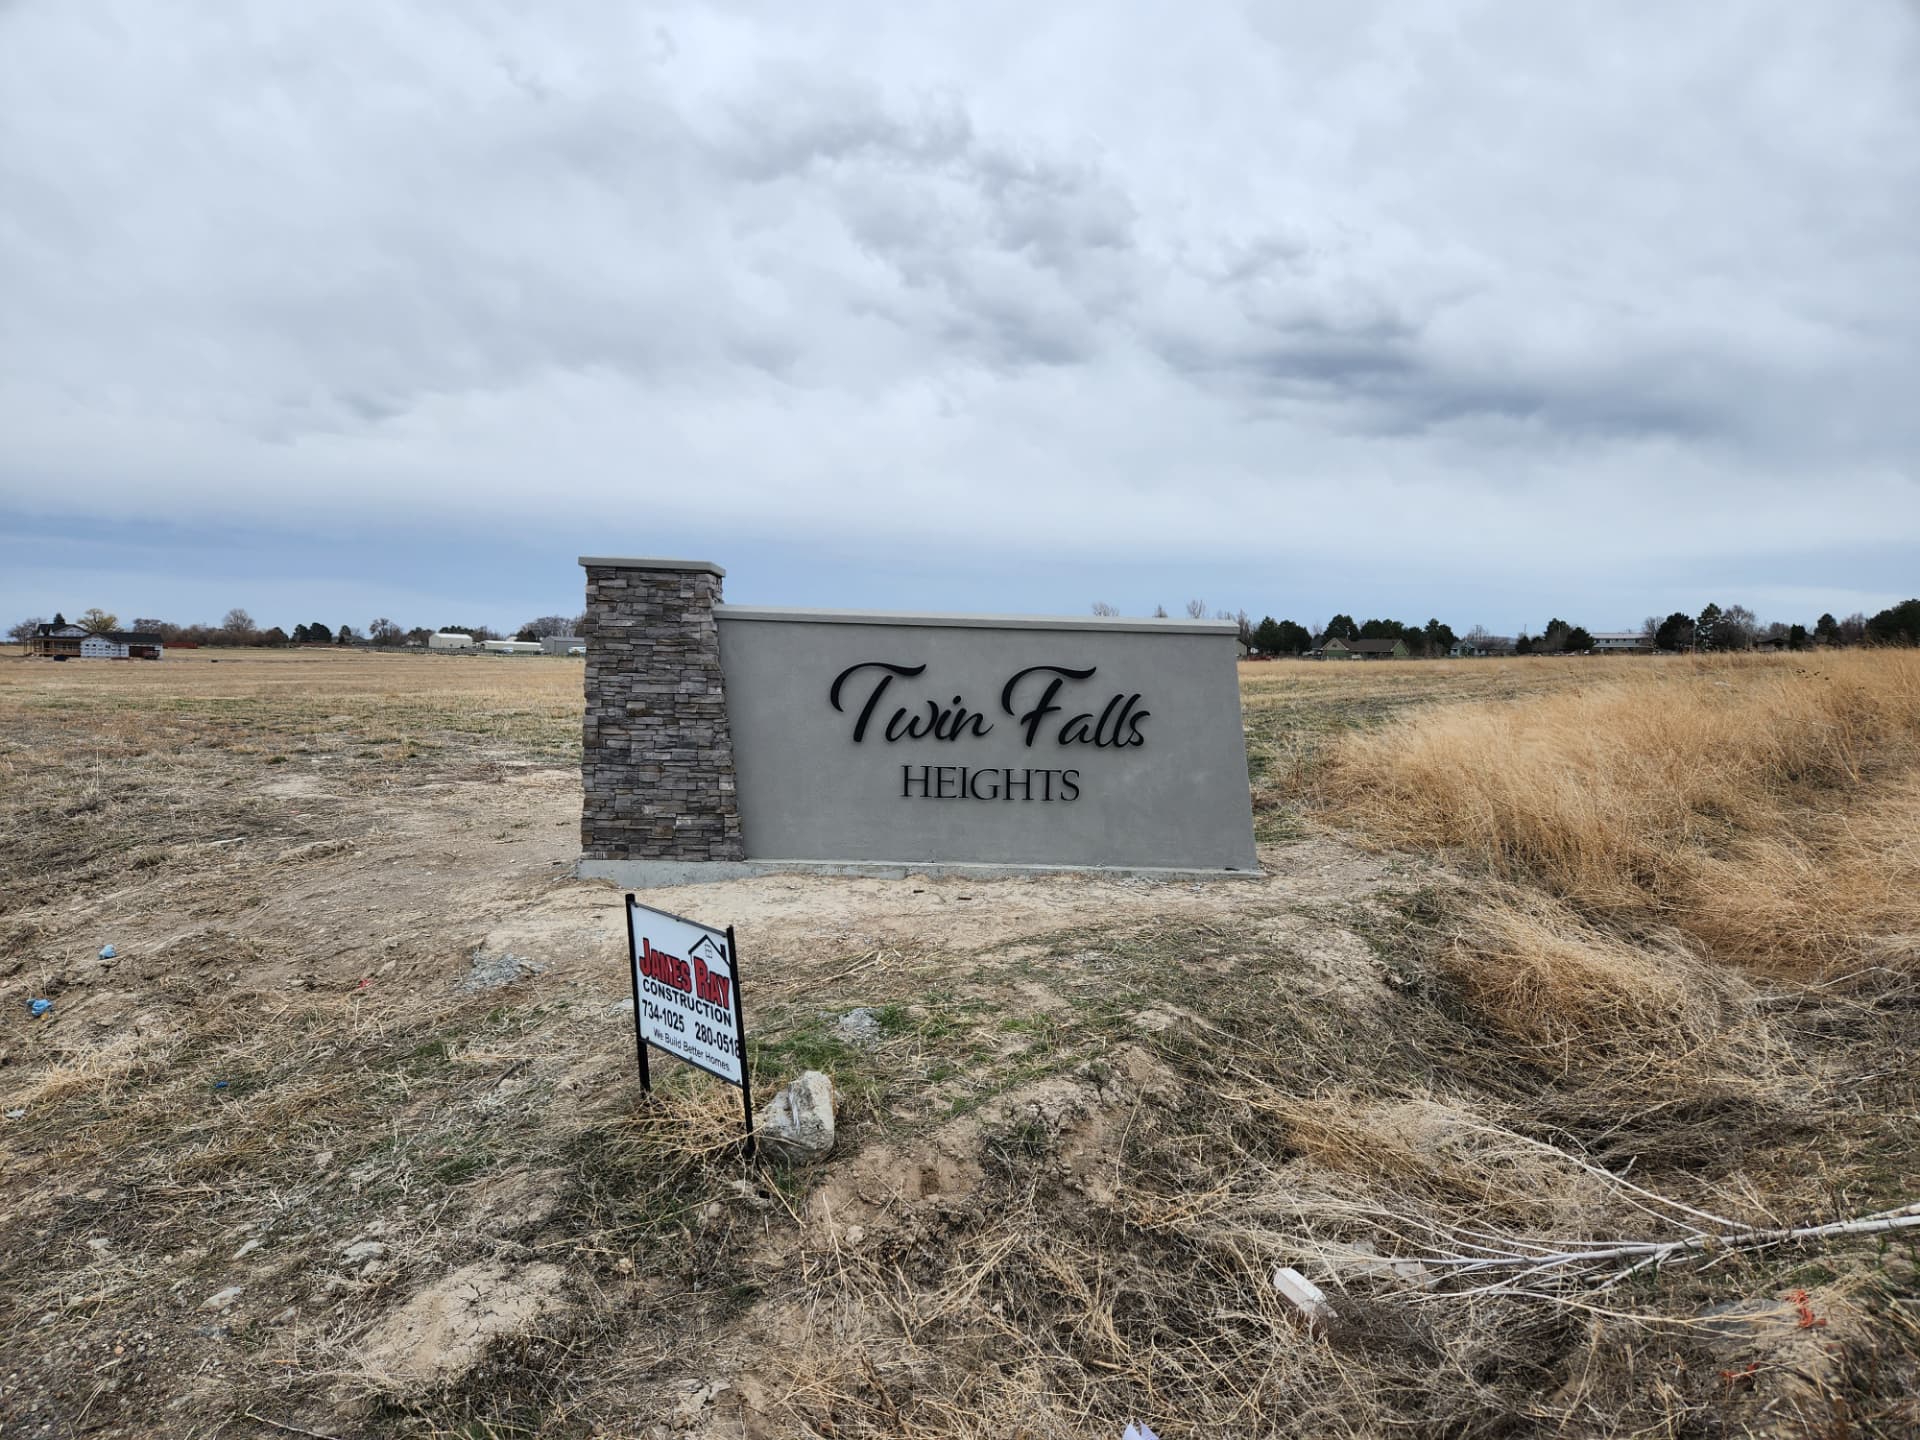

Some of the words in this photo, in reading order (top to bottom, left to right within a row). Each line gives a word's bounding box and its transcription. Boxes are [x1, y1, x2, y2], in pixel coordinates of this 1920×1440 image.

[829, 662, 994, 743] Twin
[1001, 666, 1151, 748] Falls
[901, 765, 1081, 801] HEIGHTS
[639, 937, 692, 994] JAMES
[693, 956, 730, 1010] RAY
[642, 1000, 685, 1033] 734-1025
[643, 978, 732, 1028] CONSTRUCTION
[653, 1028, 665, 1041] We
[665, 1033, 682, 1050] Build
[683, 1041, 704, 1059] Better
